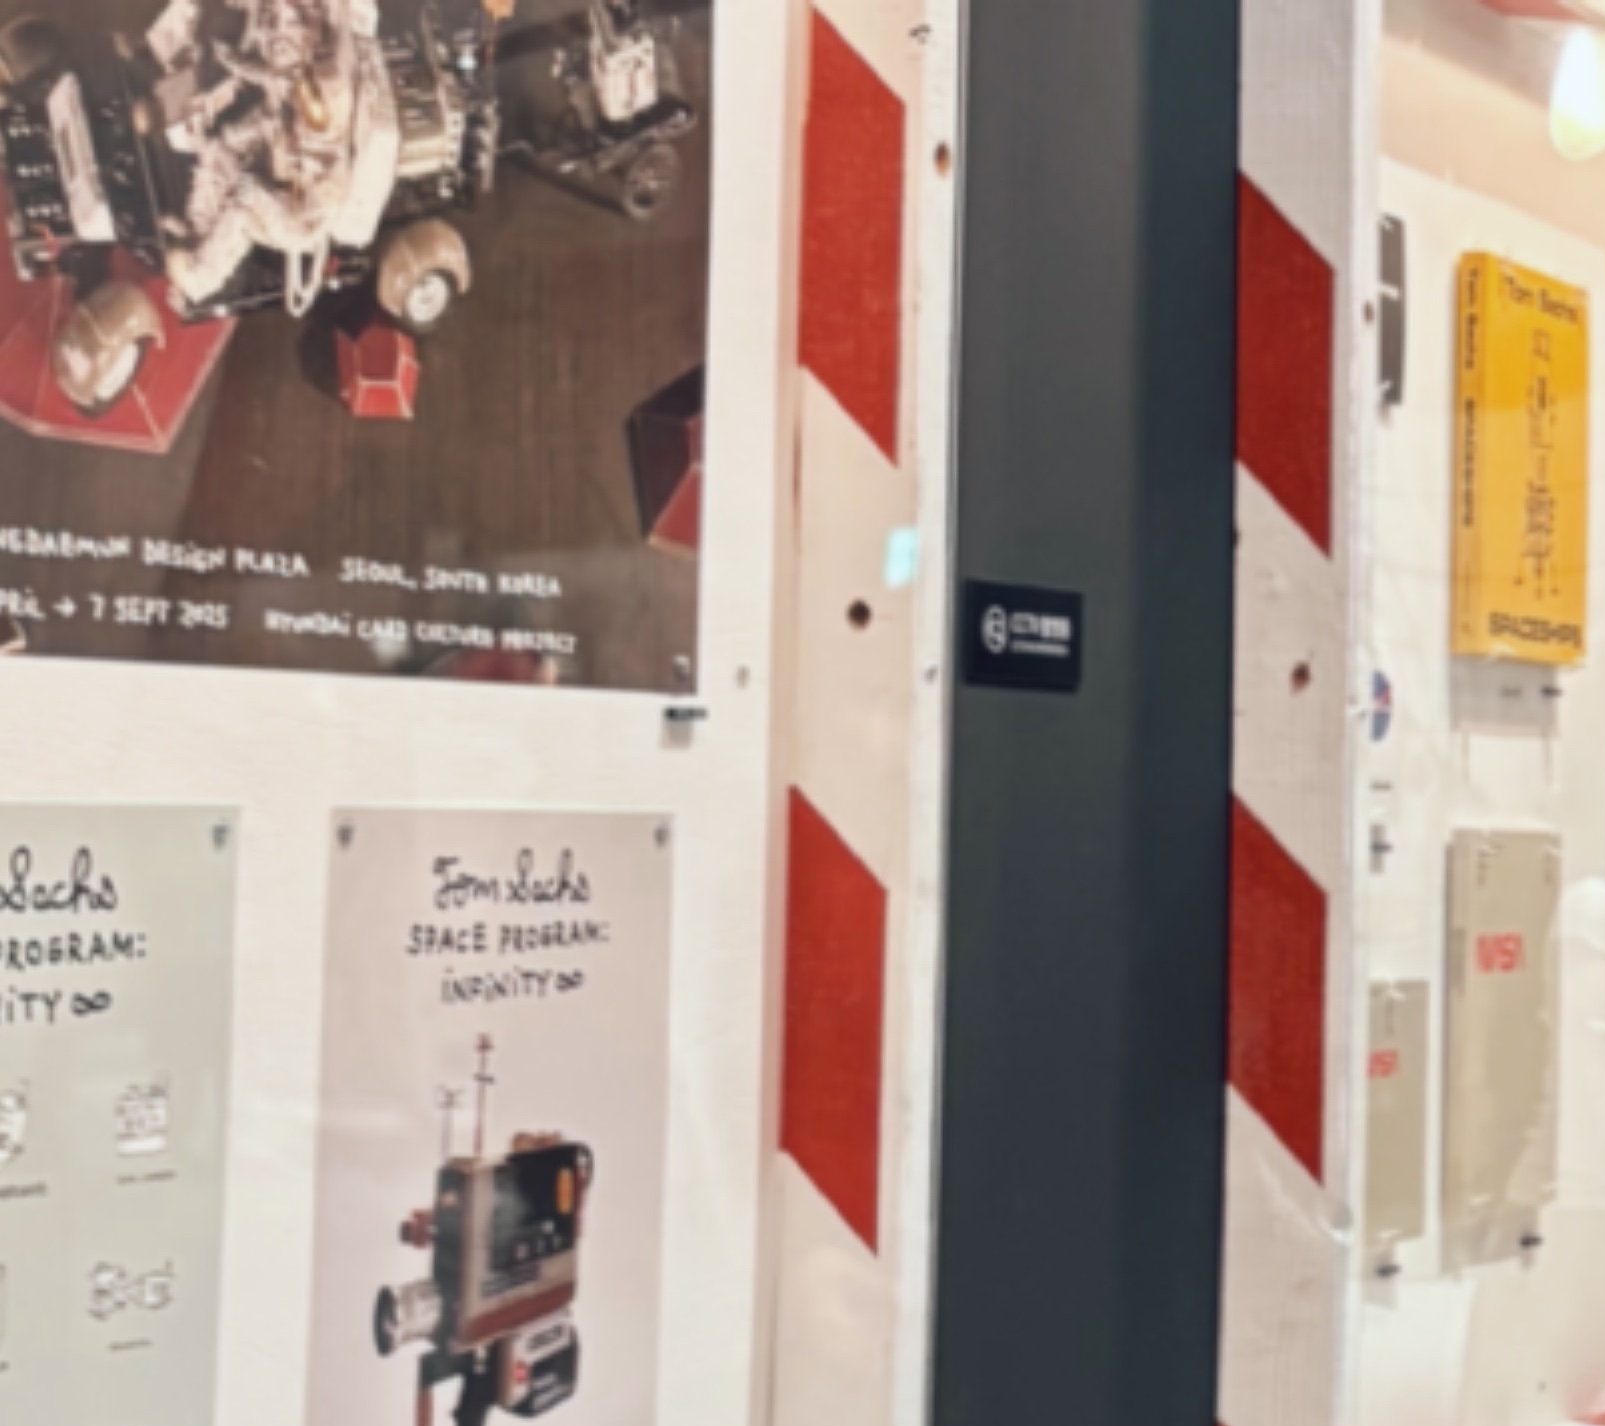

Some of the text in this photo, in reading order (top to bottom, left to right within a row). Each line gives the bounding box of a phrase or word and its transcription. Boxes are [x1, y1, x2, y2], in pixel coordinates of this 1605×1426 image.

[234, 547, 310, 578] PLAZA
[113, 595, 170, 624] SEPT
[0, 930, 147, 973] ROGRAM:
[405, 919, 489, 956] SPACE
